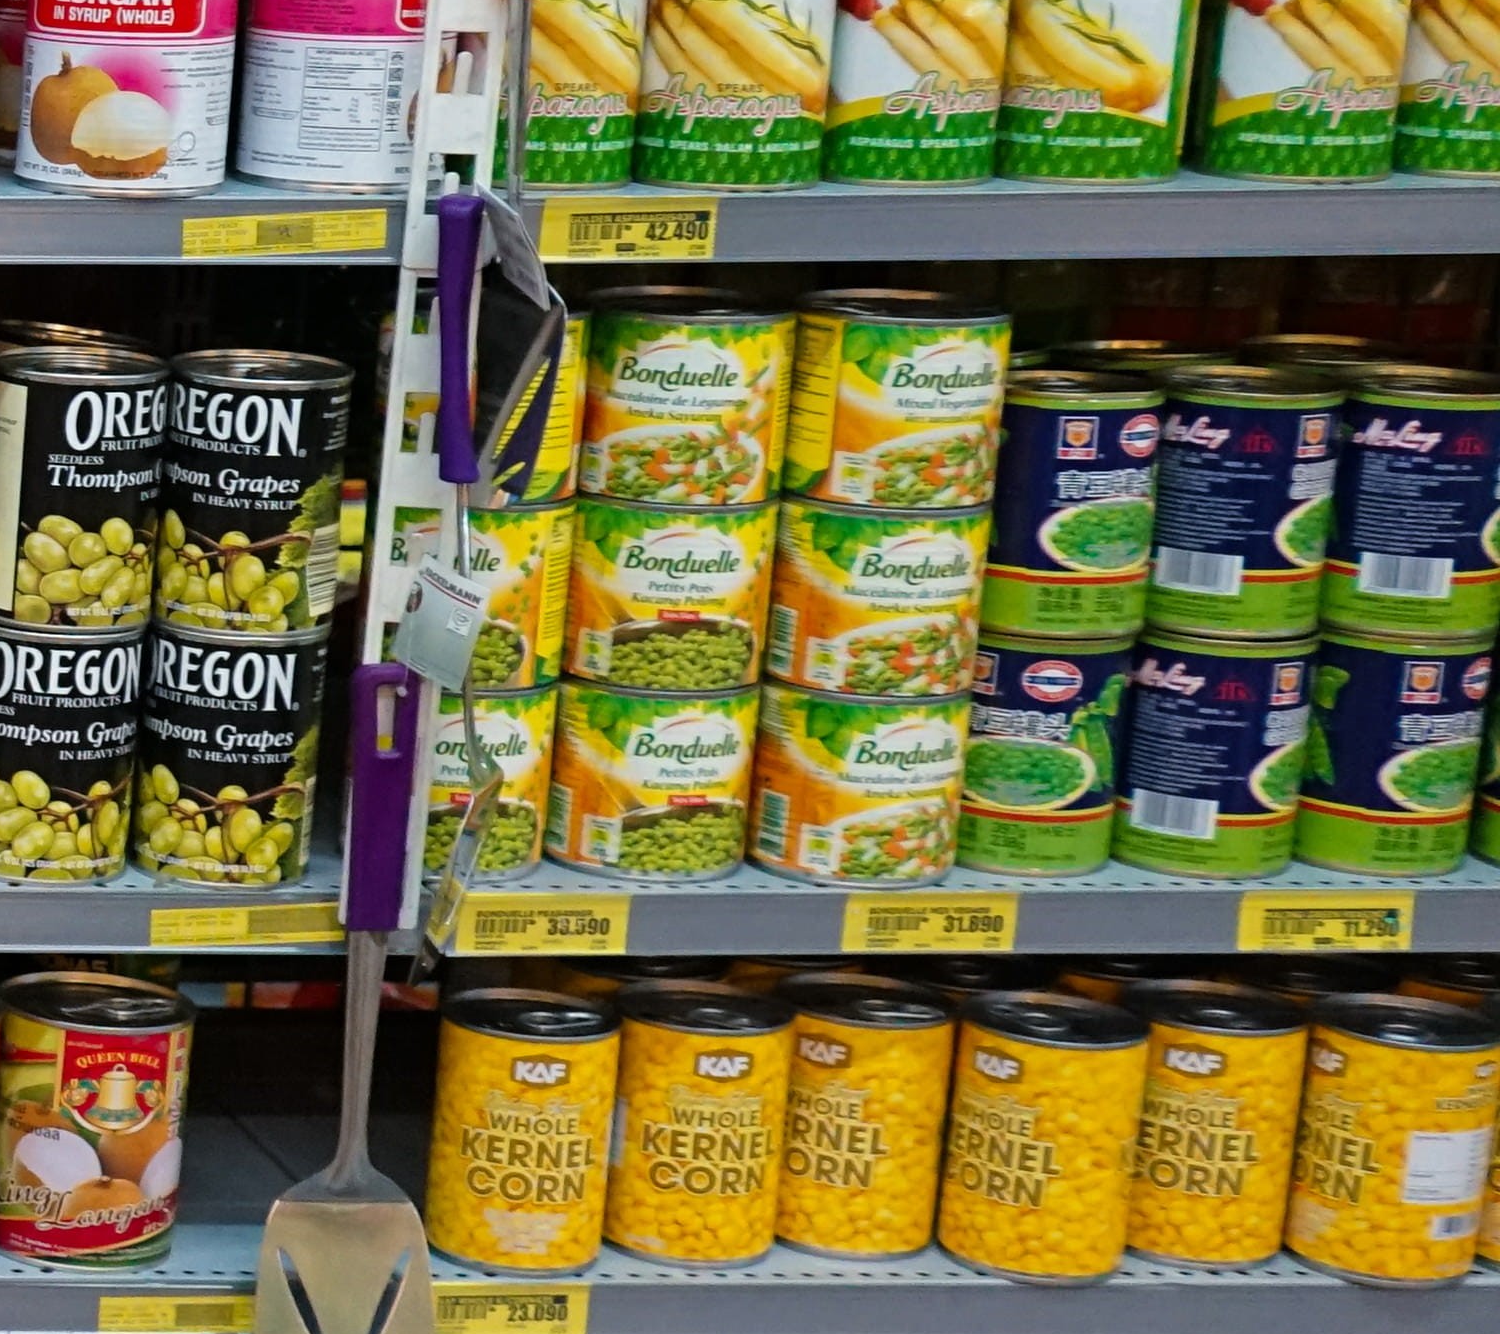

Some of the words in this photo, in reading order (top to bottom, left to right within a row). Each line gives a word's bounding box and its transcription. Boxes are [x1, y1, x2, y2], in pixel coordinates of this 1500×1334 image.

[646, 222, 708, 242] 42.490
[620, 357, 737, 391] Bonduelle
[216, 726, 293, 751] Grapes
[515, 1061, 566, 1083] KAF
[491, 1112, 578, 1135] WHOLE
[460, 1132, 594, 1166] KERNEL
[468, 1167, 586, 1201] CORN
